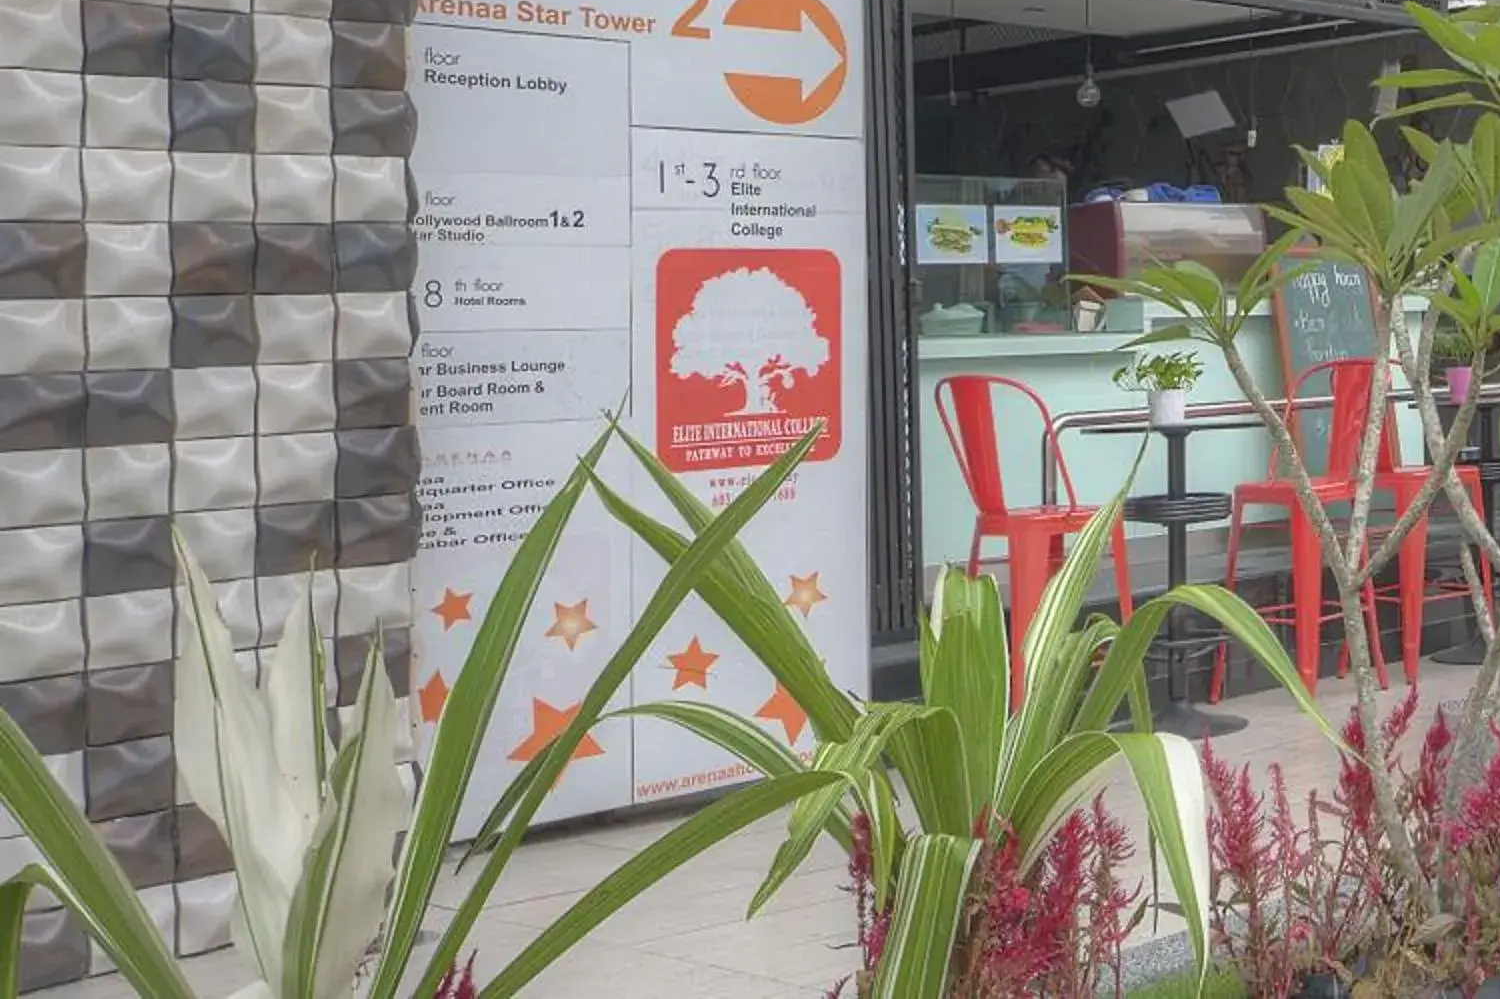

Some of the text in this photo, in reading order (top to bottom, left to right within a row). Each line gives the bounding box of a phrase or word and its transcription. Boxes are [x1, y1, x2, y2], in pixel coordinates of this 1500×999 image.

[516, 0, 573, 27] Star
[580, 6, 657, 34] Tower
[424, 46, 461, 69] floor
[424, 68, 568, 96] Reception Lobby
[752, 163, 782, 181] floor
[731, 182, 762, 197] Elite
[424, 190, 456, 207] floor
[731, 202, 817, 219] International
[411, 214, 481, 232] ollywood
[485, 214, 549, 229] Ballroom
[731, 222, 784, 241] College
[437, 228, 485, 242] Studio
[474, 278, 504, 293] floor
[454, 296, 528, 307] Hotel Rooms
[421, 343, 455, 359] floor
[437, 360, 507, 376] Business
[511, 359, 566, 375] Lounge
[437, 382, 483, 398] Board
[487, 381, 531, 395] Room
[534, 380, 546, 394] &
[420, 400, 493, 416] ent Room
[672, 424, 703, 444] ELITE
[703, 419, 783, 442] INTERNATIONAL
[685, 445, 733, 462] PATHWAY
[739, 444, 751, 457] TO
[501, 479, 556, 490] Office
[425, 507, 503, 523] lopment
